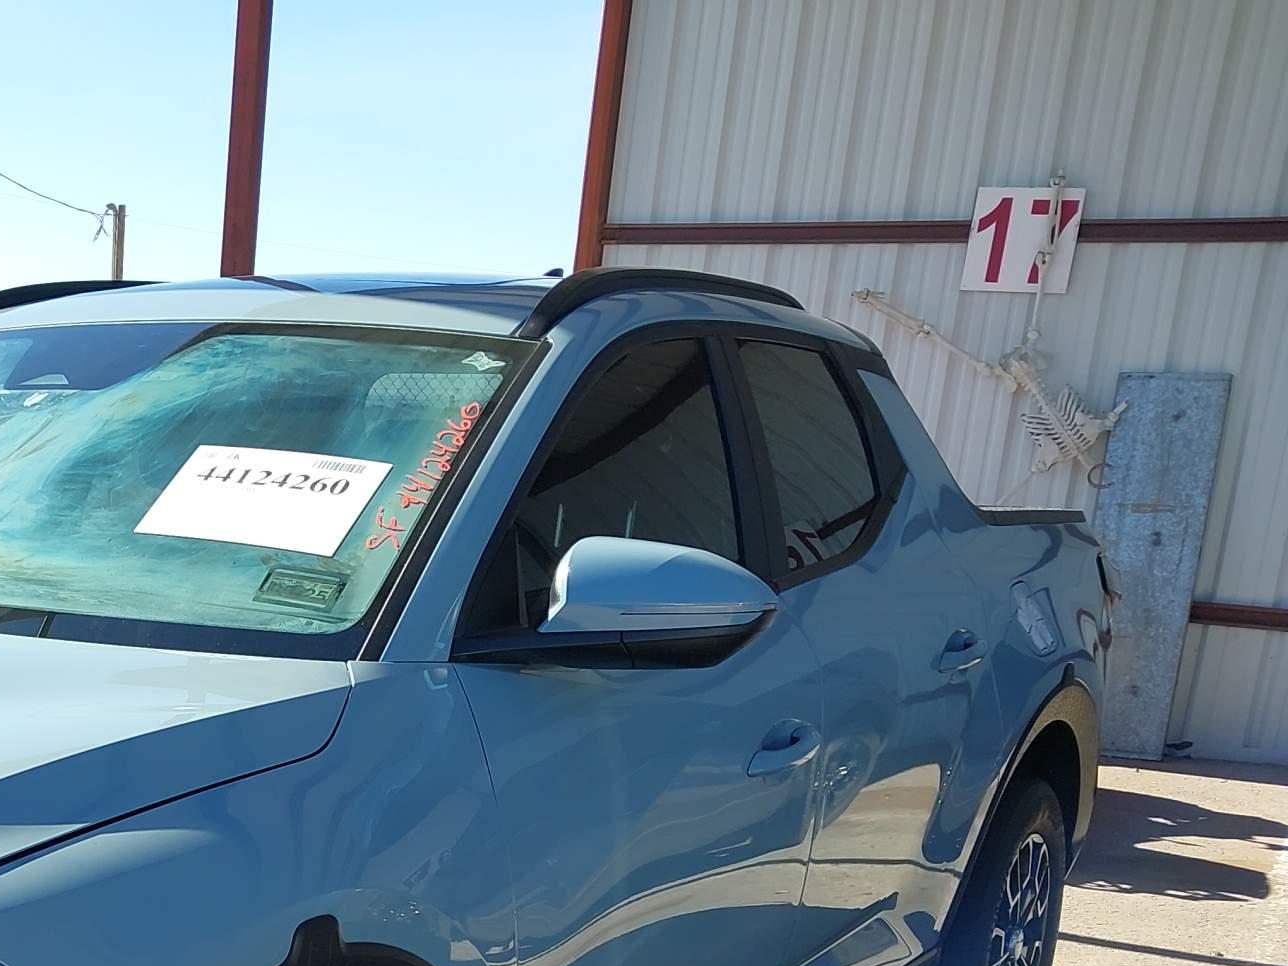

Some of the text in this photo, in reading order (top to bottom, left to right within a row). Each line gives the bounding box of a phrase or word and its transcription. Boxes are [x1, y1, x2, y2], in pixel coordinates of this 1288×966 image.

[976, 197, 1081, 285] 17
[195, 464, 351, 497] 44124260
[395, 400, 483, 510] 44124260
